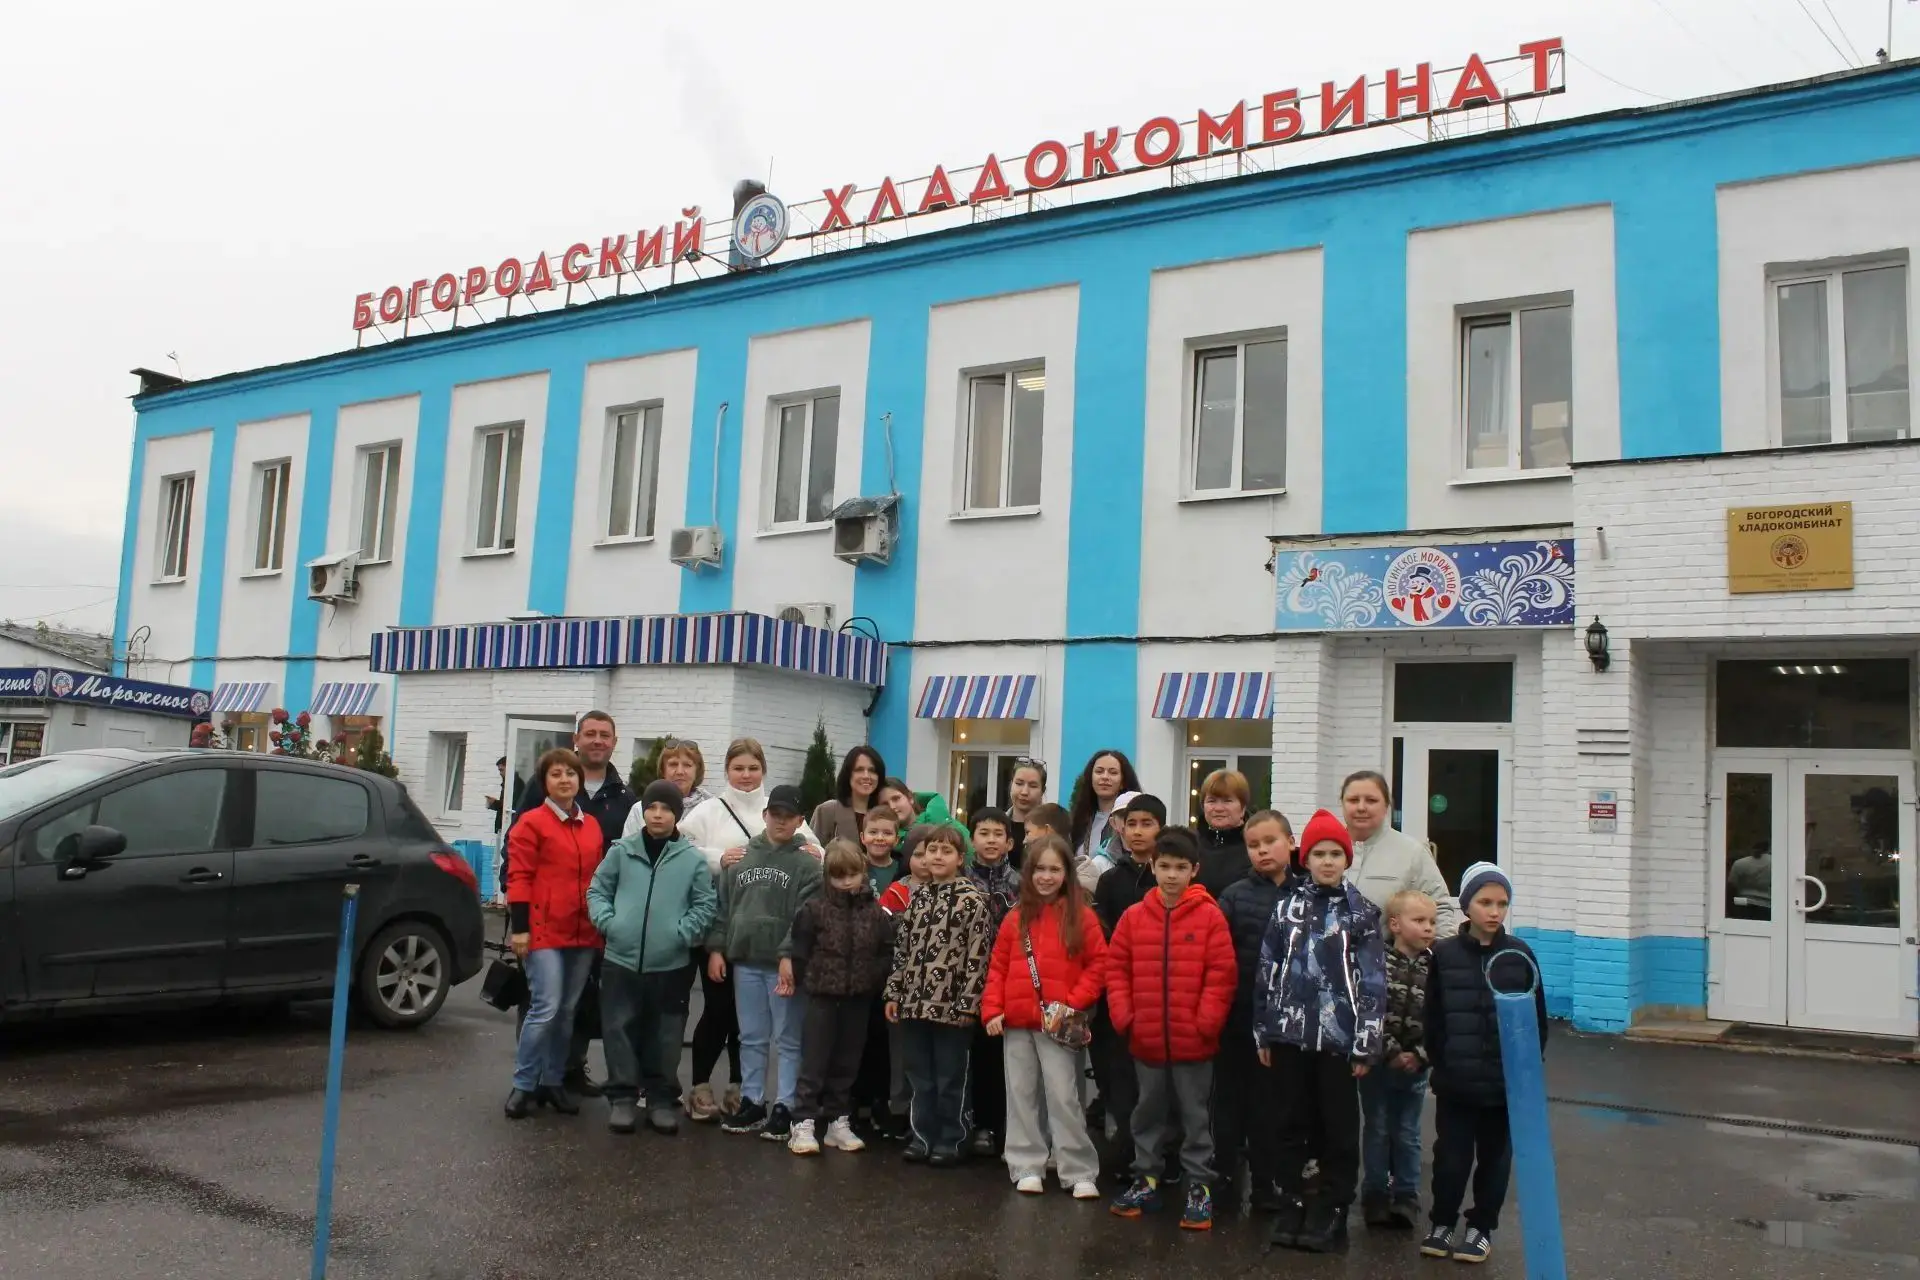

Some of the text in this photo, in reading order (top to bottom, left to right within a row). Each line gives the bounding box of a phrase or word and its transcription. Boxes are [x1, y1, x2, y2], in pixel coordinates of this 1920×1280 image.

[353, 36, 1564, 330] БОГОРОДСКИЙ ХЛАДОКОМБИНАТ
[1738, 518, 1843, 533] ХЛАДОКОМБИНАТ
[1746, 505, 1833, 520] БОГОРОДСКИЙ
[1387, 551, 1457, 597] НОГИНСКОЕ МОРОЖЕНОЕ
[73, 675, 189, 709] Мороженое
[738, 867, 791, 889] VARSITY
